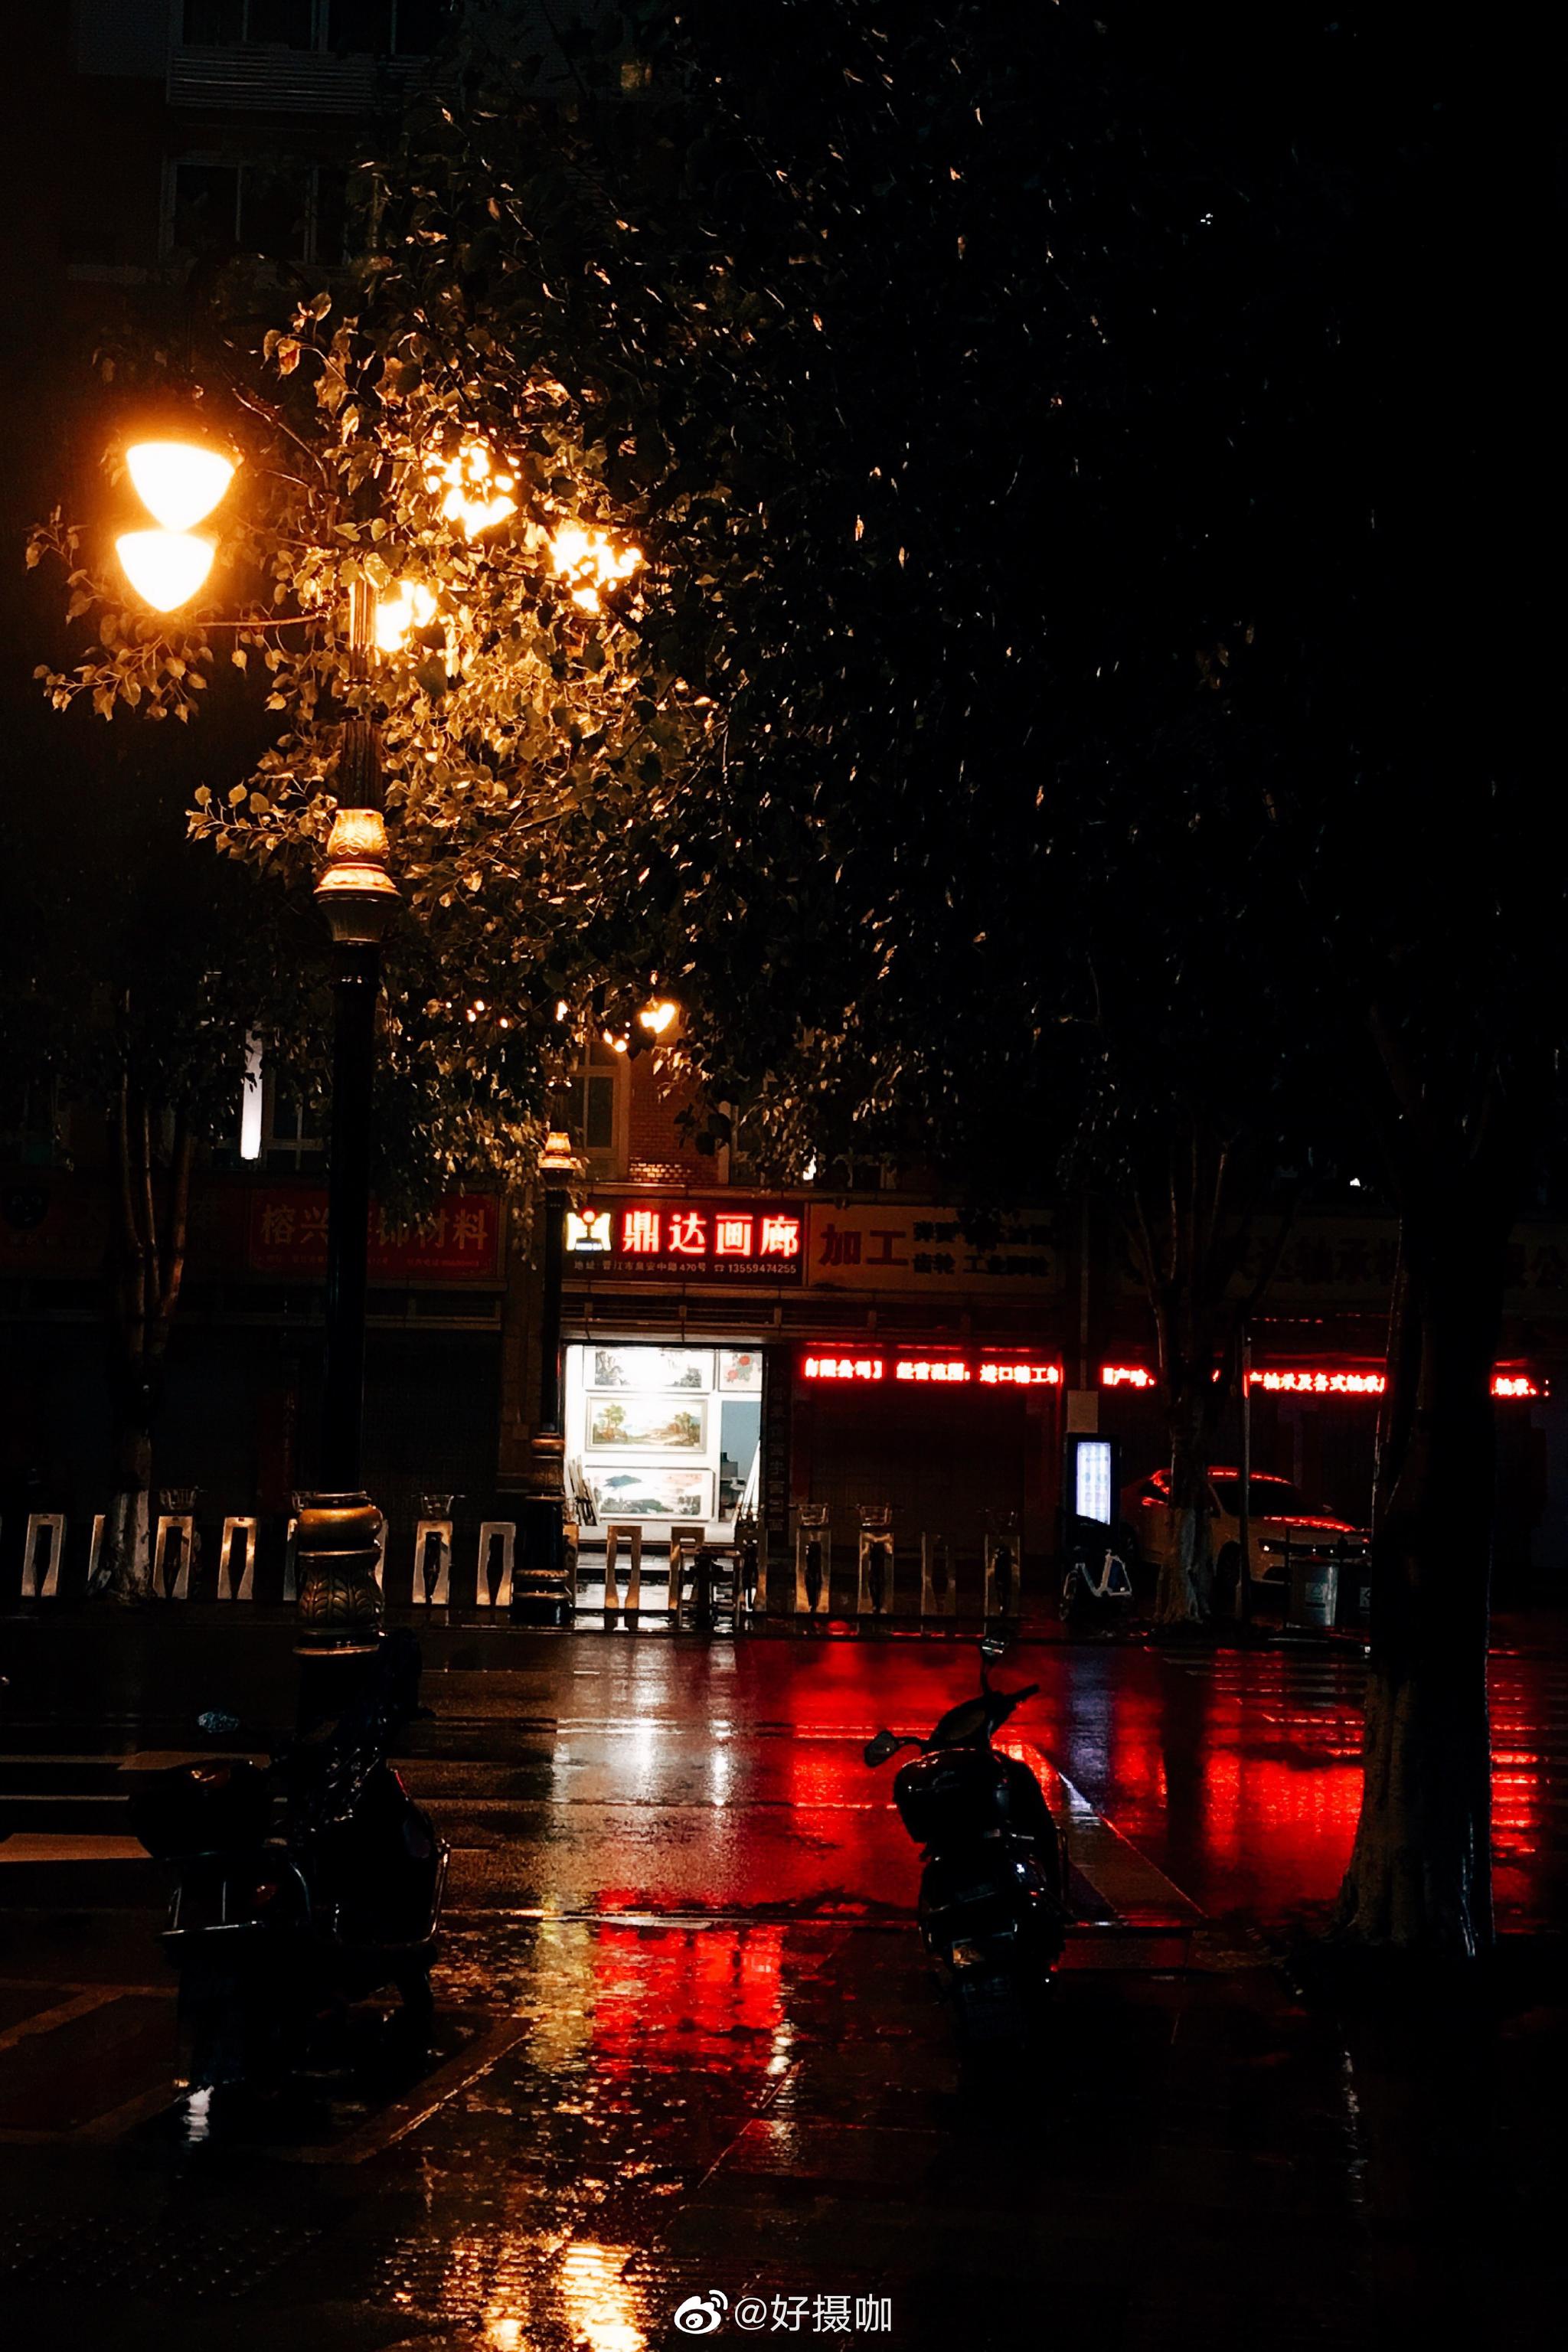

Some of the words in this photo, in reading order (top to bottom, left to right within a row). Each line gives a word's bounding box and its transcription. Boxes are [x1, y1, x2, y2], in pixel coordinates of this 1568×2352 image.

[622, 1210, 800, 1259] 鼎达画廊
[818, 1223, 909, 1266] 加工
[727, 1263, 797, 1274] 13559474255
